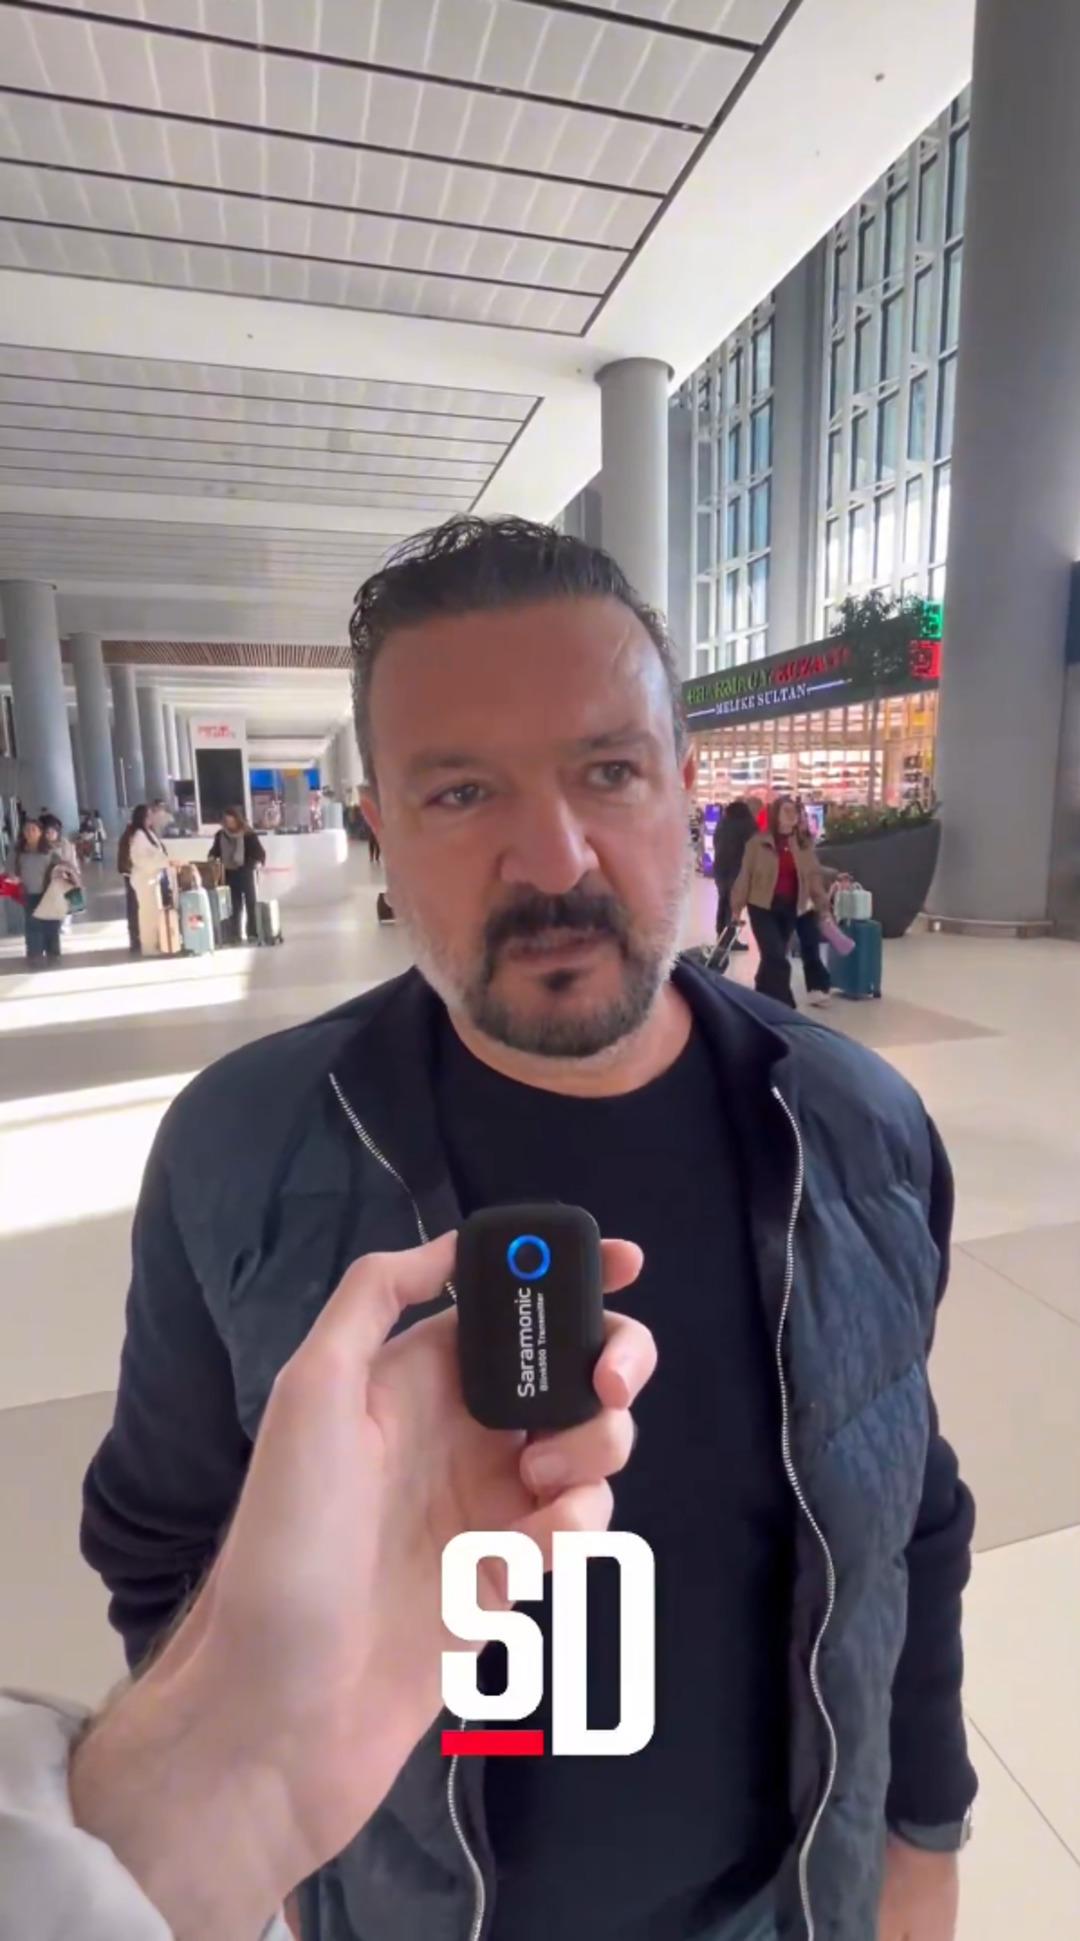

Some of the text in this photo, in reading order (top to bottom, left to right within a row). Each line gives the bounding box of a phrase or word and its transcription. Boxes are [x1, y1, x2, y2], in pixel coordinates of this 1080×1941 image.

[757, 683, 807, 706] SULTAN
[514, 1287, 535, 1398] Saramonic
[537, 1293, 546, 1346] Transmitter
